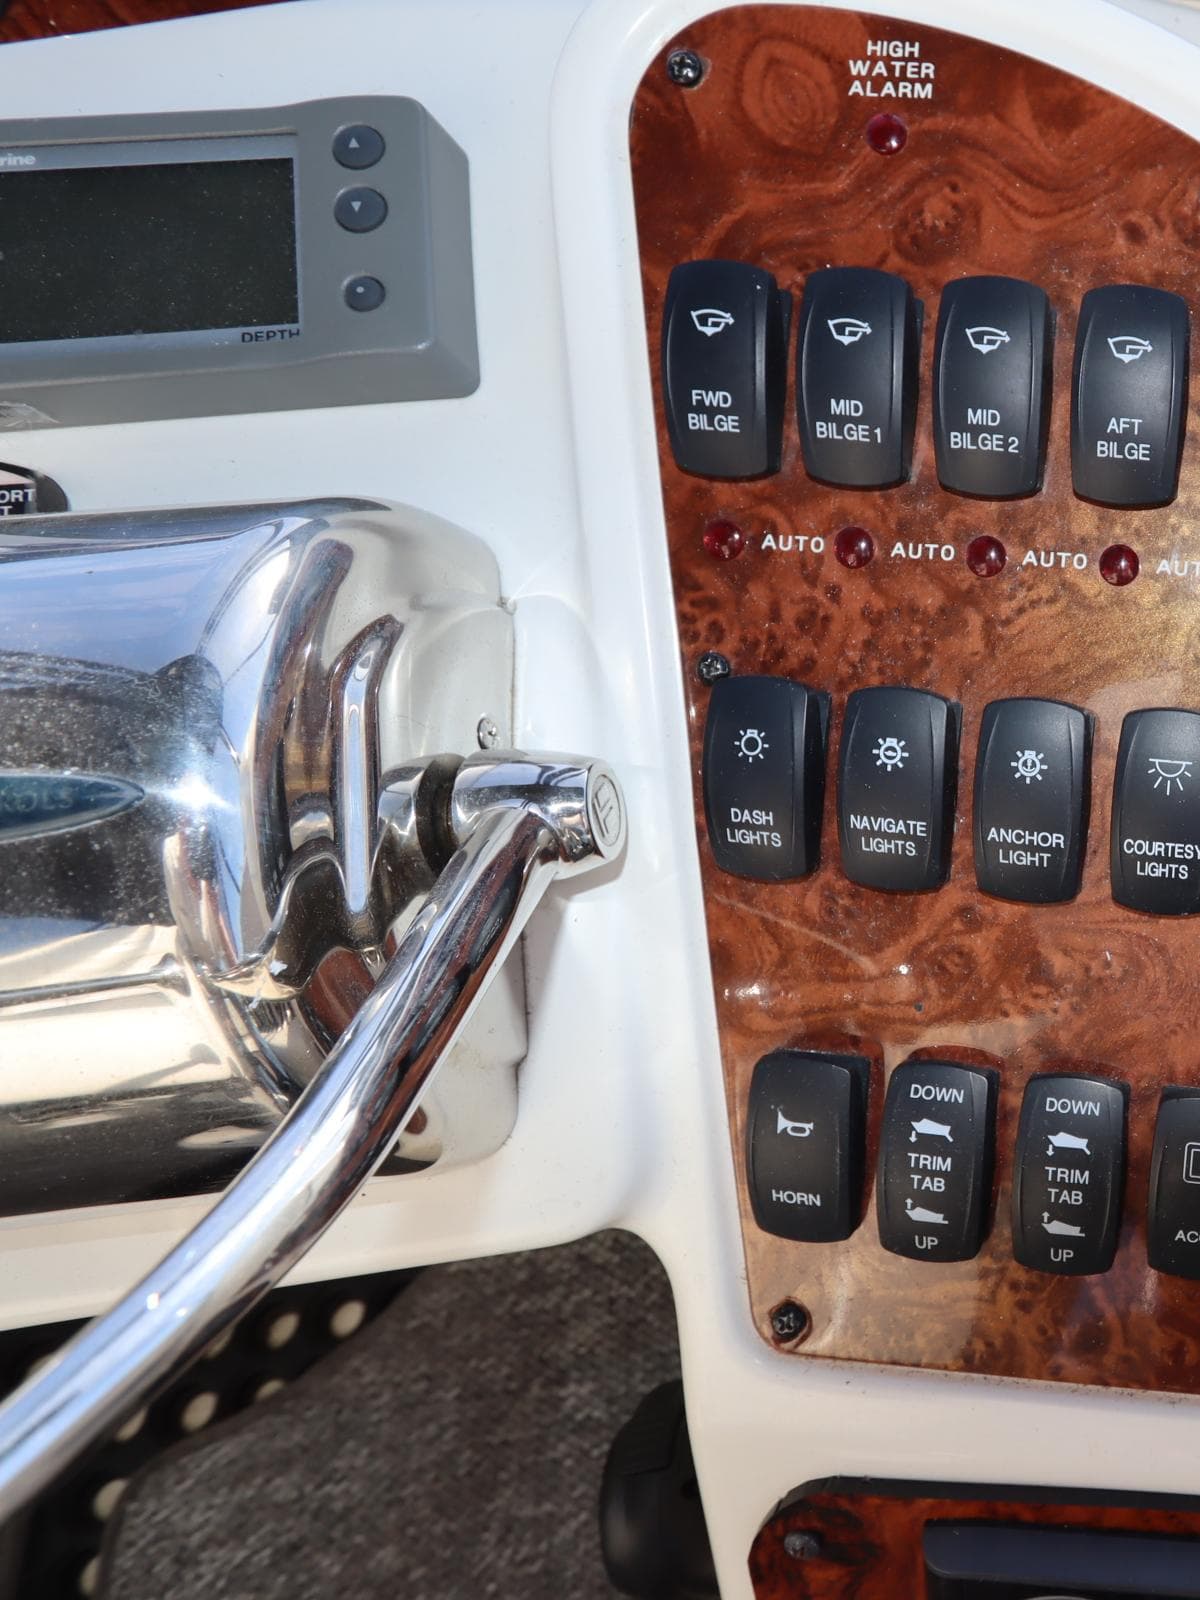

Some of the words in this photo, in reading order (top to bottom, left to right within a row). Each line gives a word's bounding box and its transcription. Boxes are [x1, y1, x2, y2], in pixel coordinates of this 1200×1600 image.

[866, 39, 920, 58] HIGH
[848, 59, 935, 79] WATER
[848, 79, 933, 99] ALARM
[240, 327, 301, 344] DEPTH
[691, 389, 732, 408] FWD
[830, 398, 864, 417] MID
[687, 413, 741, 433] BILGE
[967, 407, 1001, 427] MID
[1106, 417, 1144, 436] AFT
[815, 421, 871, 443] BILGE
[874, 427, 882, 444] 1
[950, 431, 1005, 452] BILGE
[1007, 436, 1019, 454] 2
[1096, 440, 1151, 461] BILGE
[761, 533, 825, 554] AUTO
[890, 541, 955, 562] AUTO
[1021, 550, 1088, 570] AUTO
[730, 807, 774, 827] DASH
[850, 814, 927, 837] NAVIGATE
[726, 827, 782, 848] LIGHTS
[861, 836, 916, 857] LIGHTS
[987, 826, 1065, 849] ANCHOR
[999, 848, 1052, 868] LIGHT
[1136, 860, 1189, 880] LIGHTS
[909, 1083, 965, 1104] DOWN
[1045, 1097, 1101, 1117] DOWN
[907, 1152, 952, 1172] TRIM
[910, 1174, 946, 1193] TAB
[1044, 1166, 1090, 1185] TRIM
[771, 1189, 821, 1207] HORN
[1047, 1187, 1083, 1205] TAB
[914, 1234, 939, 1250] UP
[1050, 1247, 1074, 1263] UP
